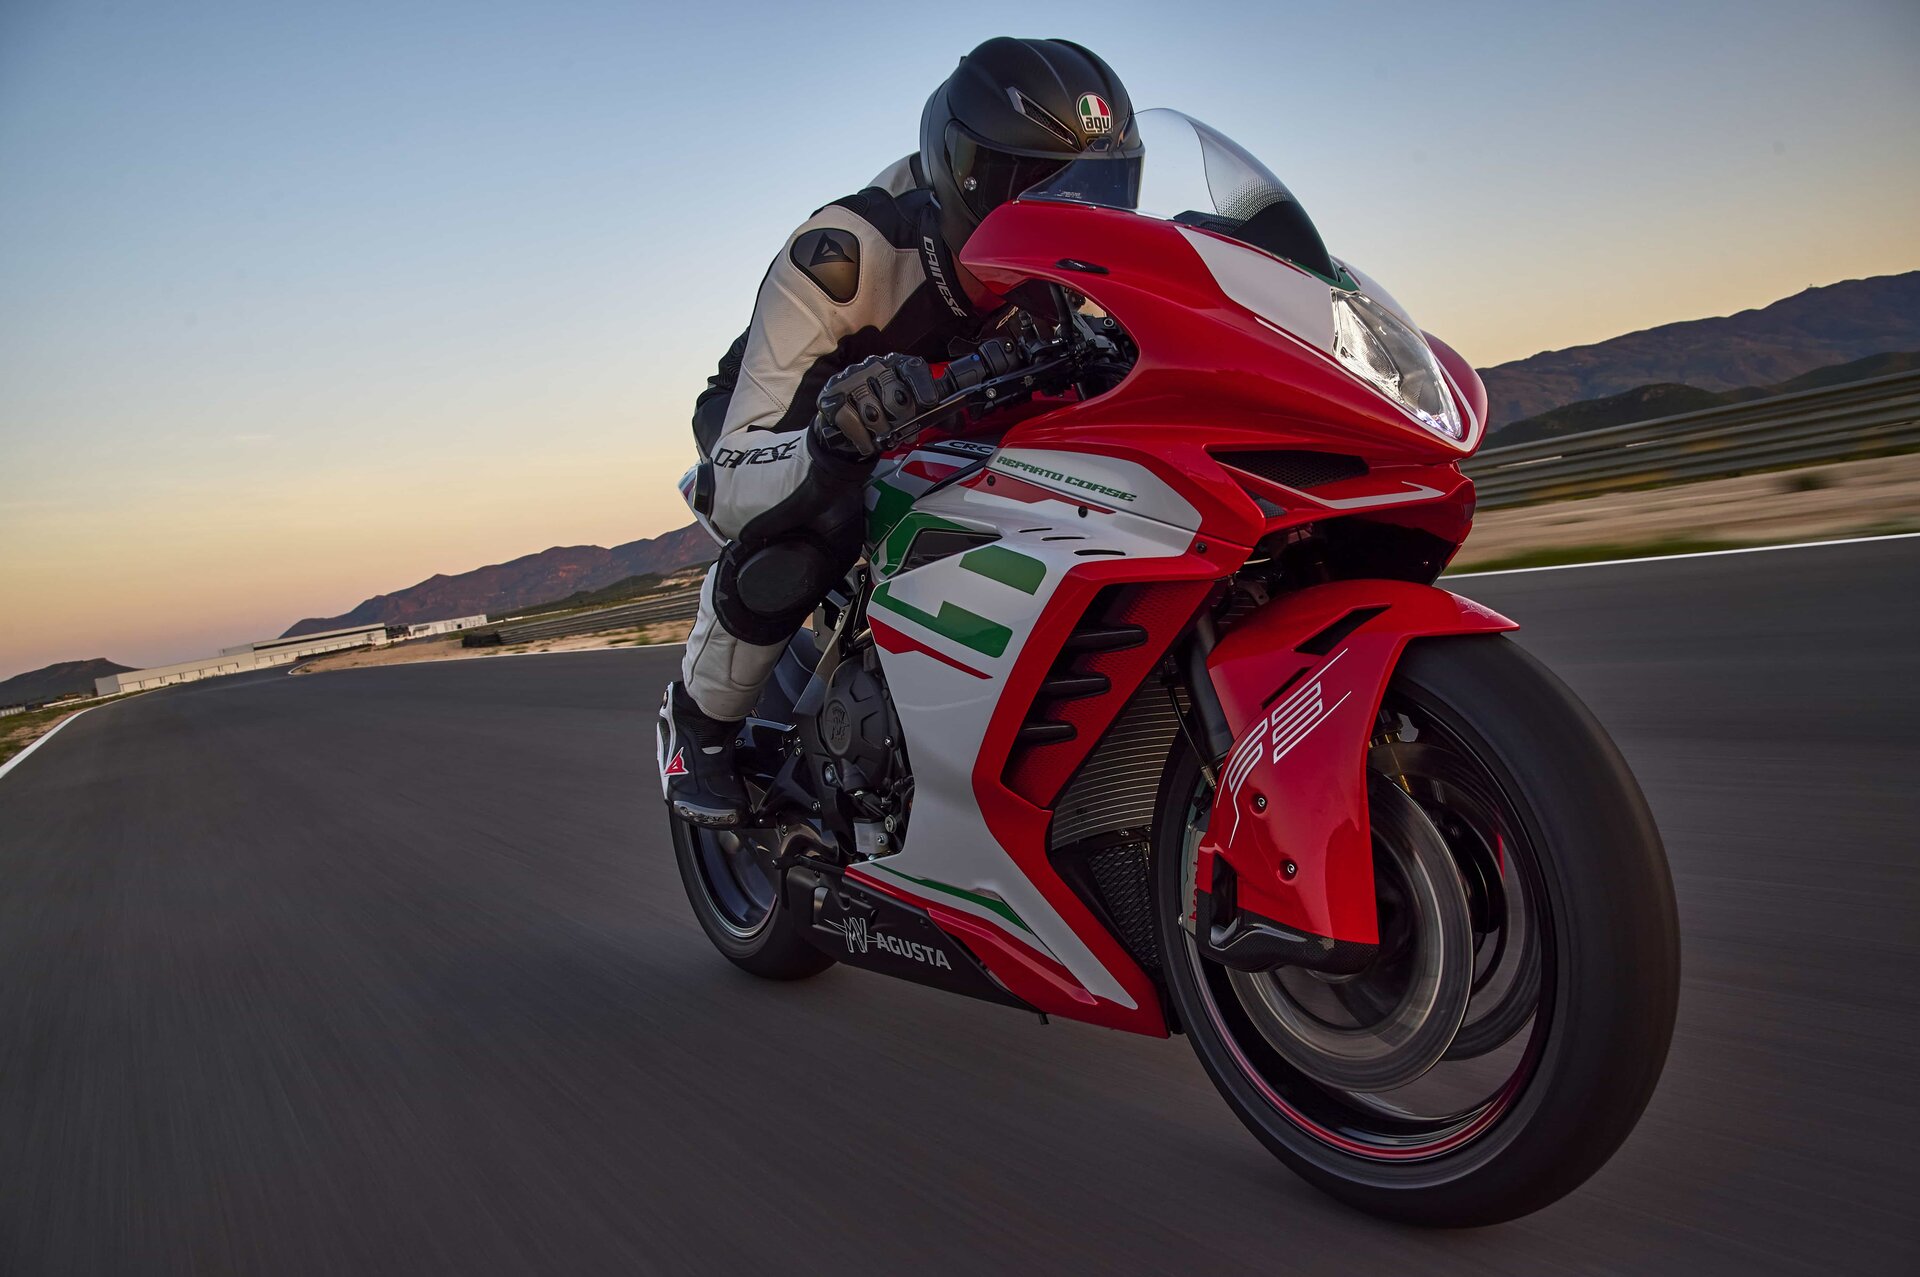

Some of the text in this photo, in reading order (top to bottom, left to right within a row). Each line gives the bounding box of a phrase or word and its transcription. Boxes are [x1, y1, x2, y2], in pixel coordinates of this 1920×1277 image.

[1085, 116, 1110, 133] agv
[923, 236, 968, 317] DAINESE
[948, 441, 994, 454] CRC
[996, 456, 1138, 502] REPARTO CORSE
[876, 931, 953, 971] AGUSTA
